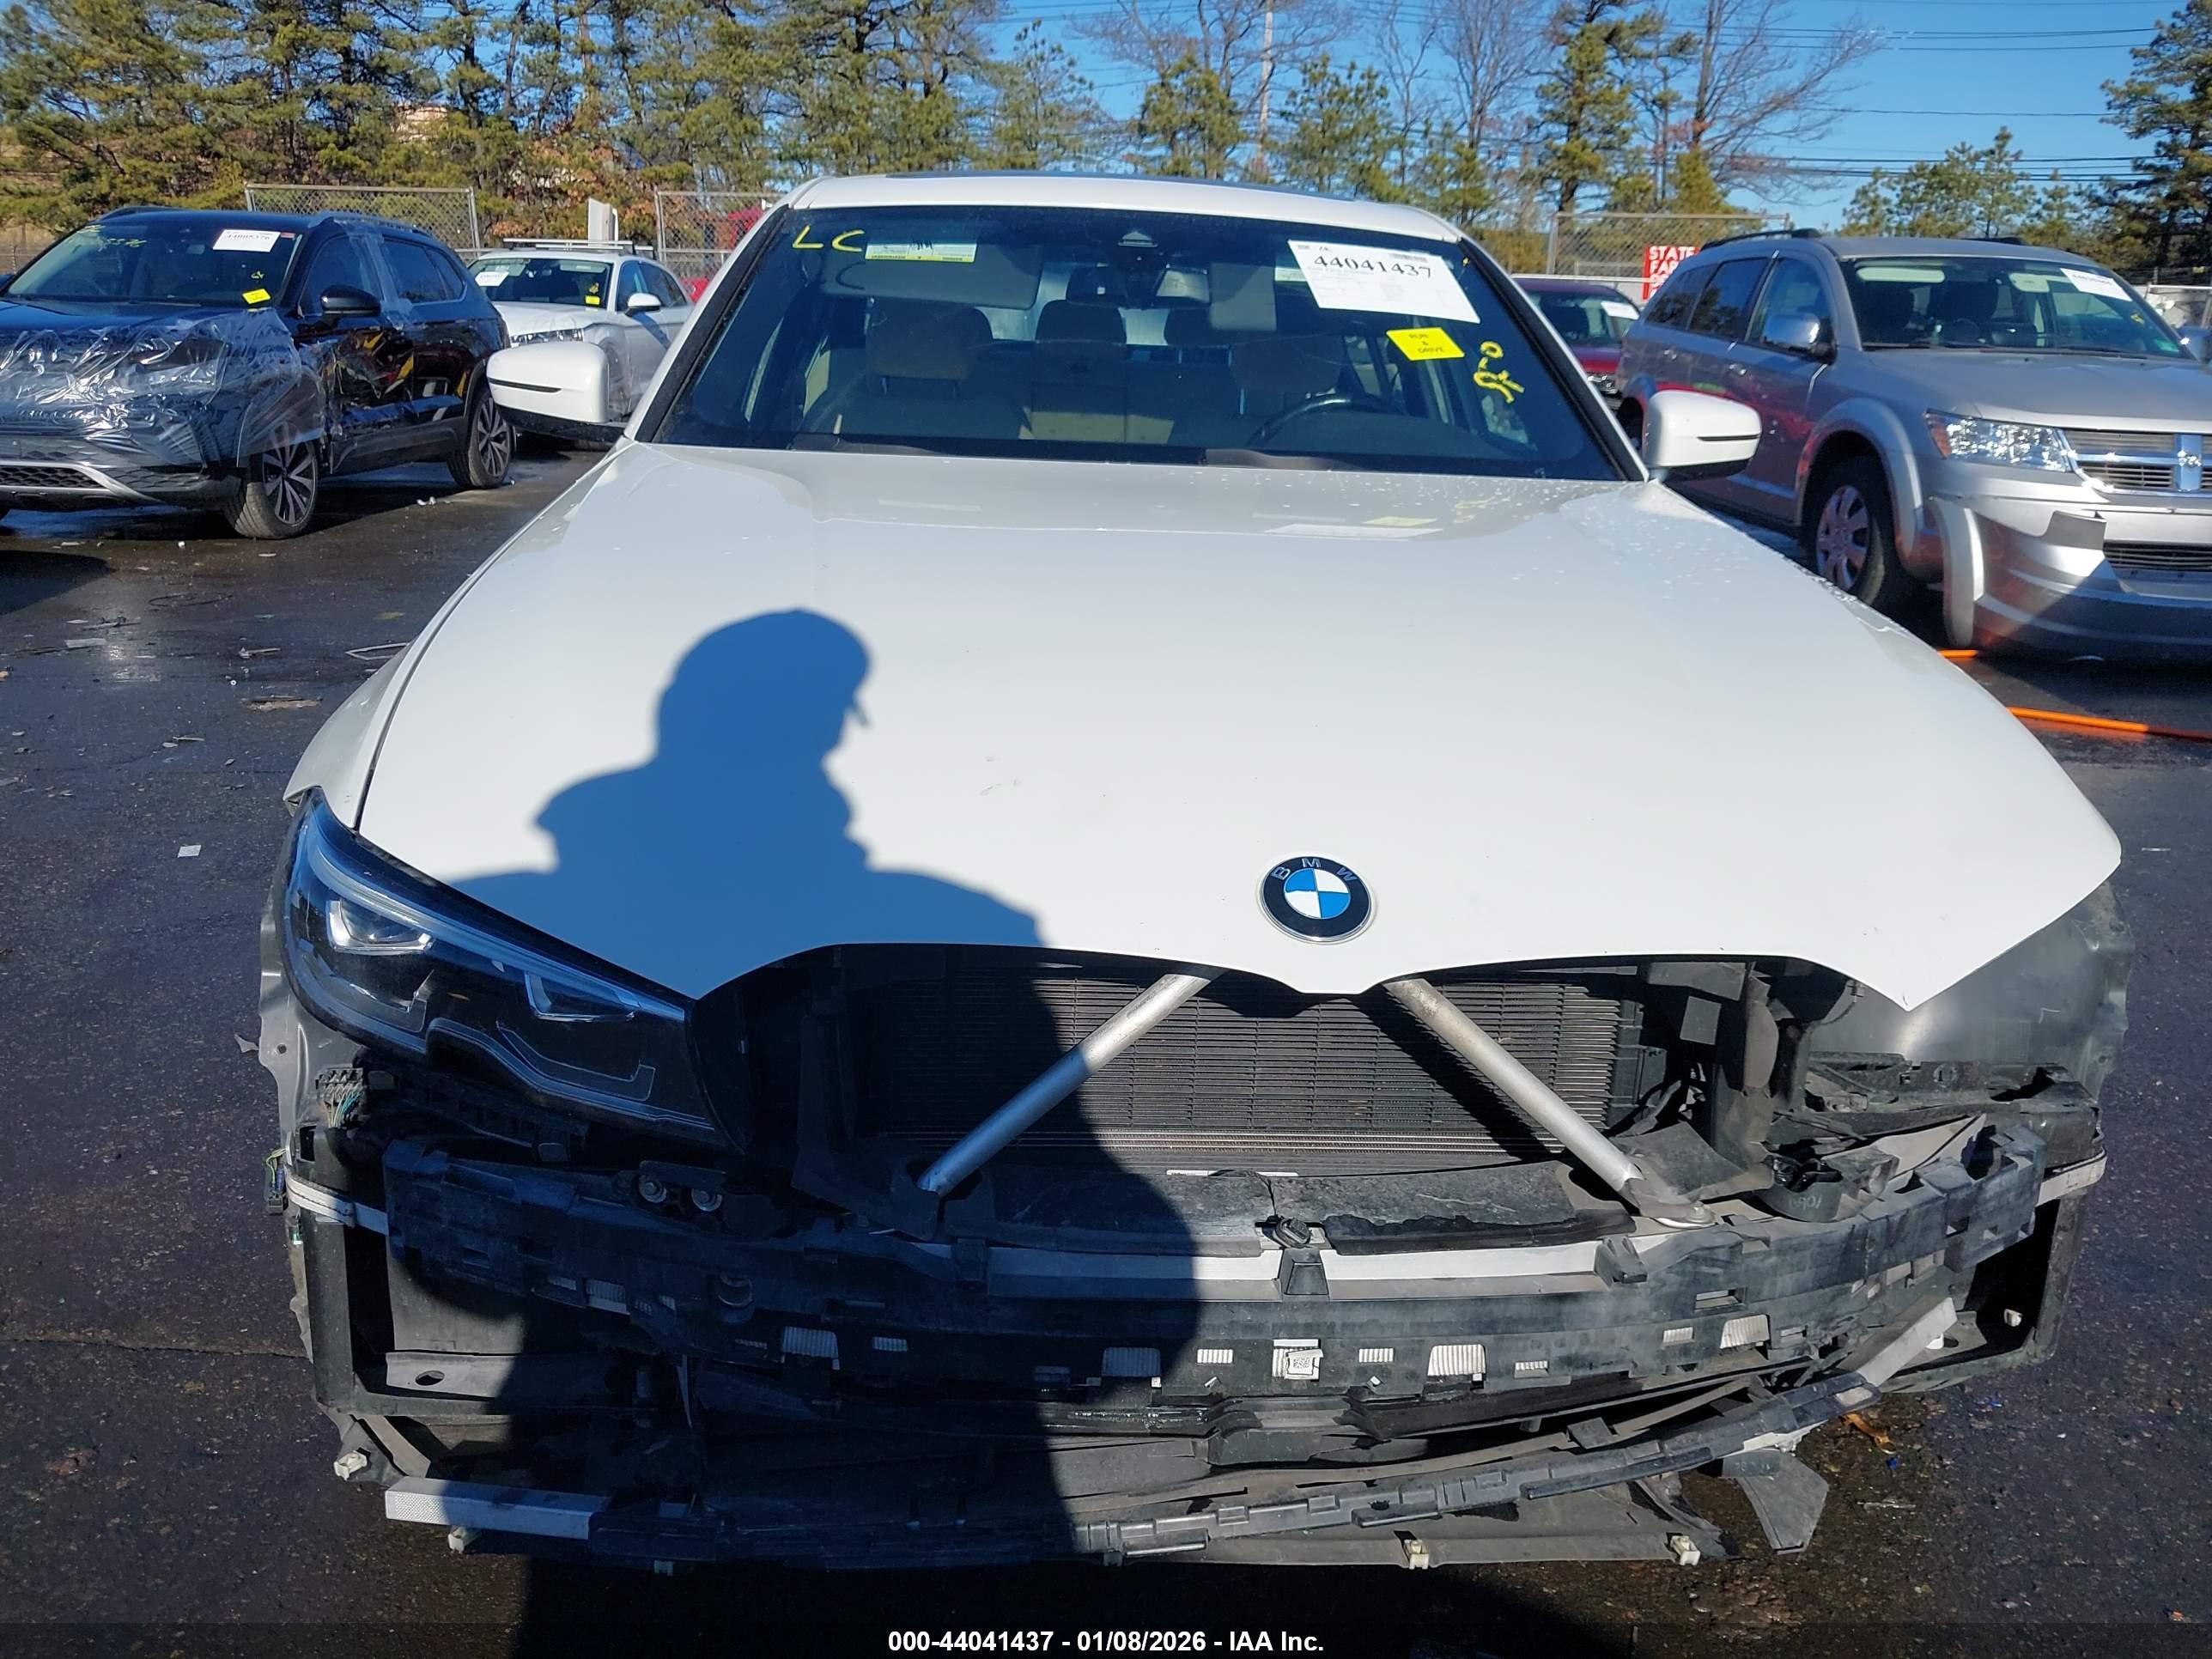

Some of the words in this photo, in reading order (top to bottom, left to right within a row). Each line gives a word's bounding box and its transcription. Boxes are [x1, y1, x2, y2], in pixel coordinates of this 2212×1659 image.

[1649, 246, 1697, 262] STATE
[1315, 256, 1431, 278] 44041437
[1271, 858, 1358, 882] BMW
